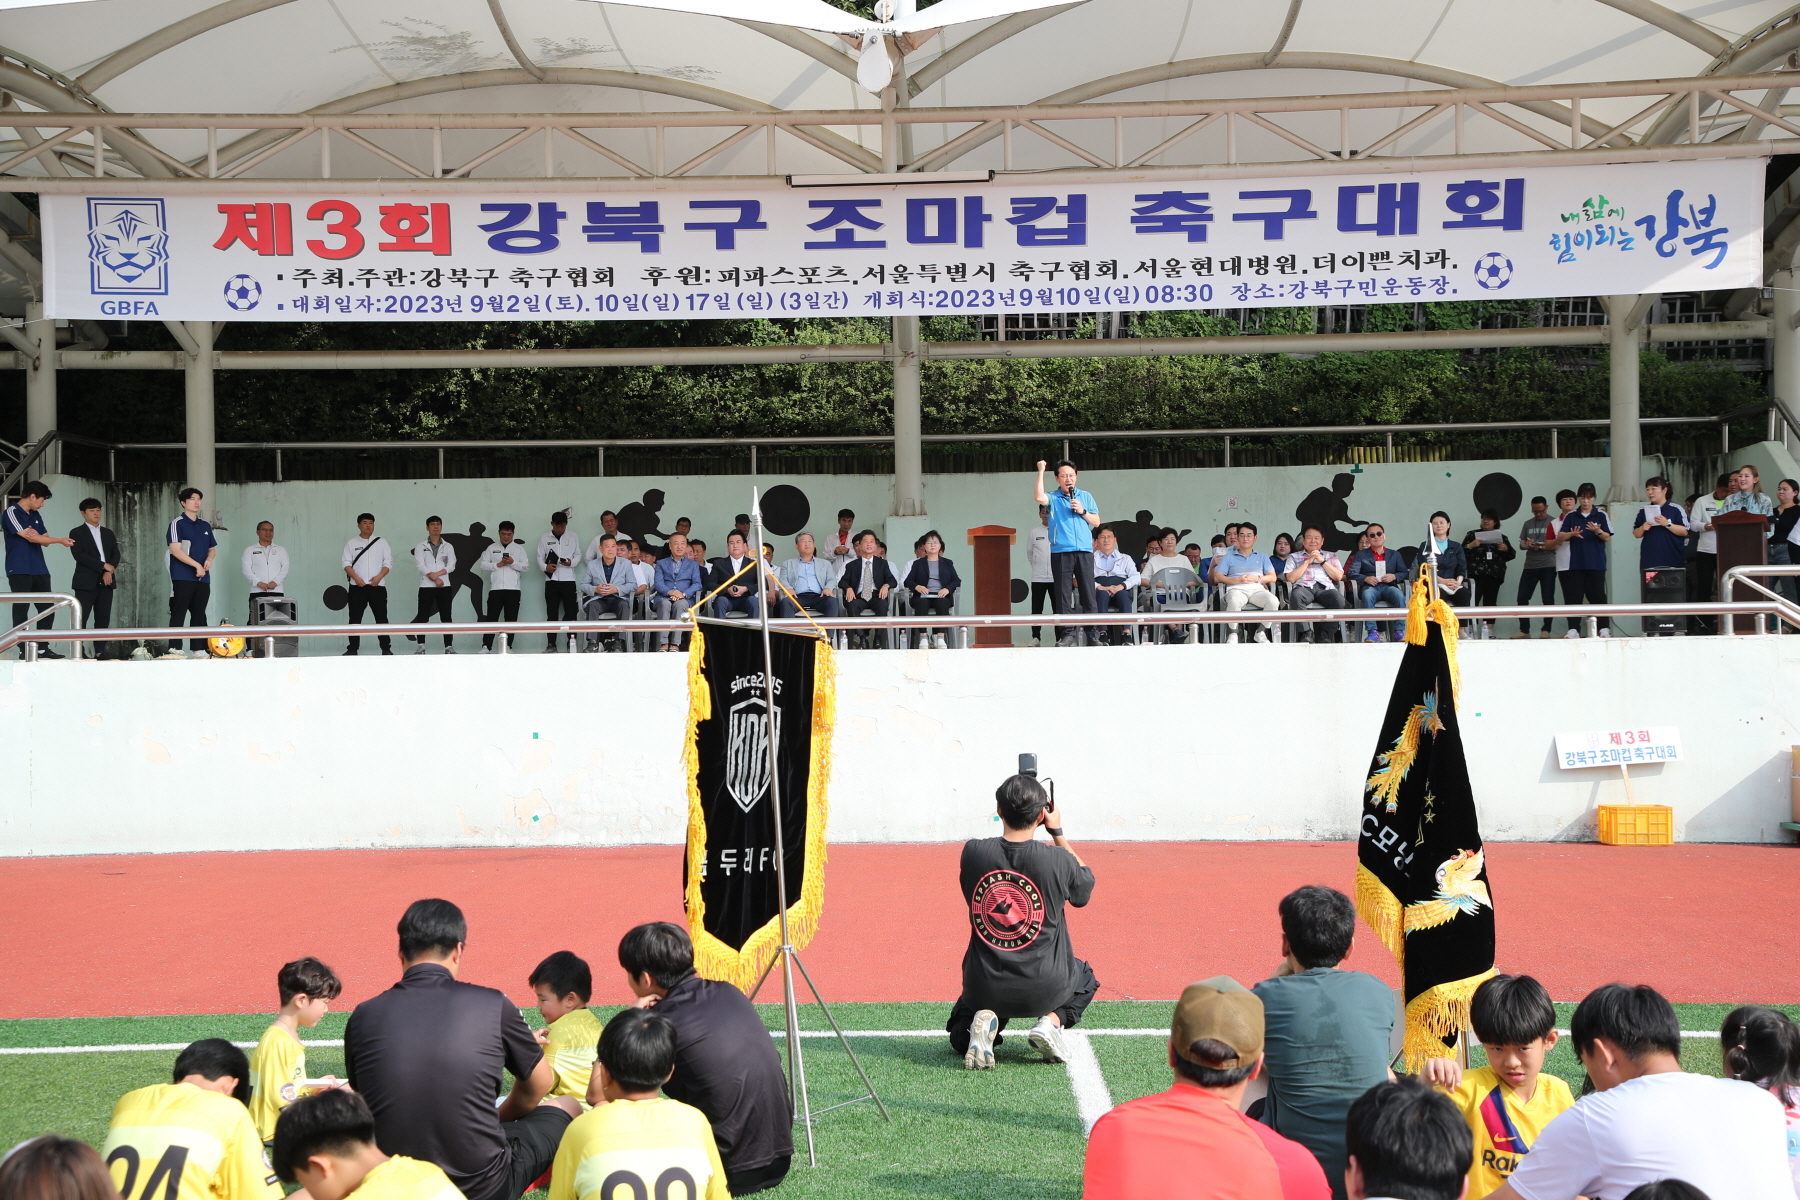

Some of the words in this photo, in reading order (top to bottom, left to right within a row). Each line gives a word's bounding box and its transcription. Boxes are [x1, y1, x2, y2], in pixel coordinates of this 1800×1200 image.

[213, 200, 452, 260] 제3회
[477, 200, 767, 254] 강북구
[804, 194, 1089, 250] 조마컵
[1131, 178, 1525, 243] 축구대회
[1634, 189, 1729, 270] 강북
[508, 267, 614, 289] 축구협회
[100, 300, 160, 316] GBFA
[1565, 750, 1598, 766] 강북구
[1600, 748, 1632, 763] 조마컵
[1634, 745, 1677, 761] 축구대회
[975, 873, 1011, 902] SPLASH
[1018, 879, 1041, 909] COOL
